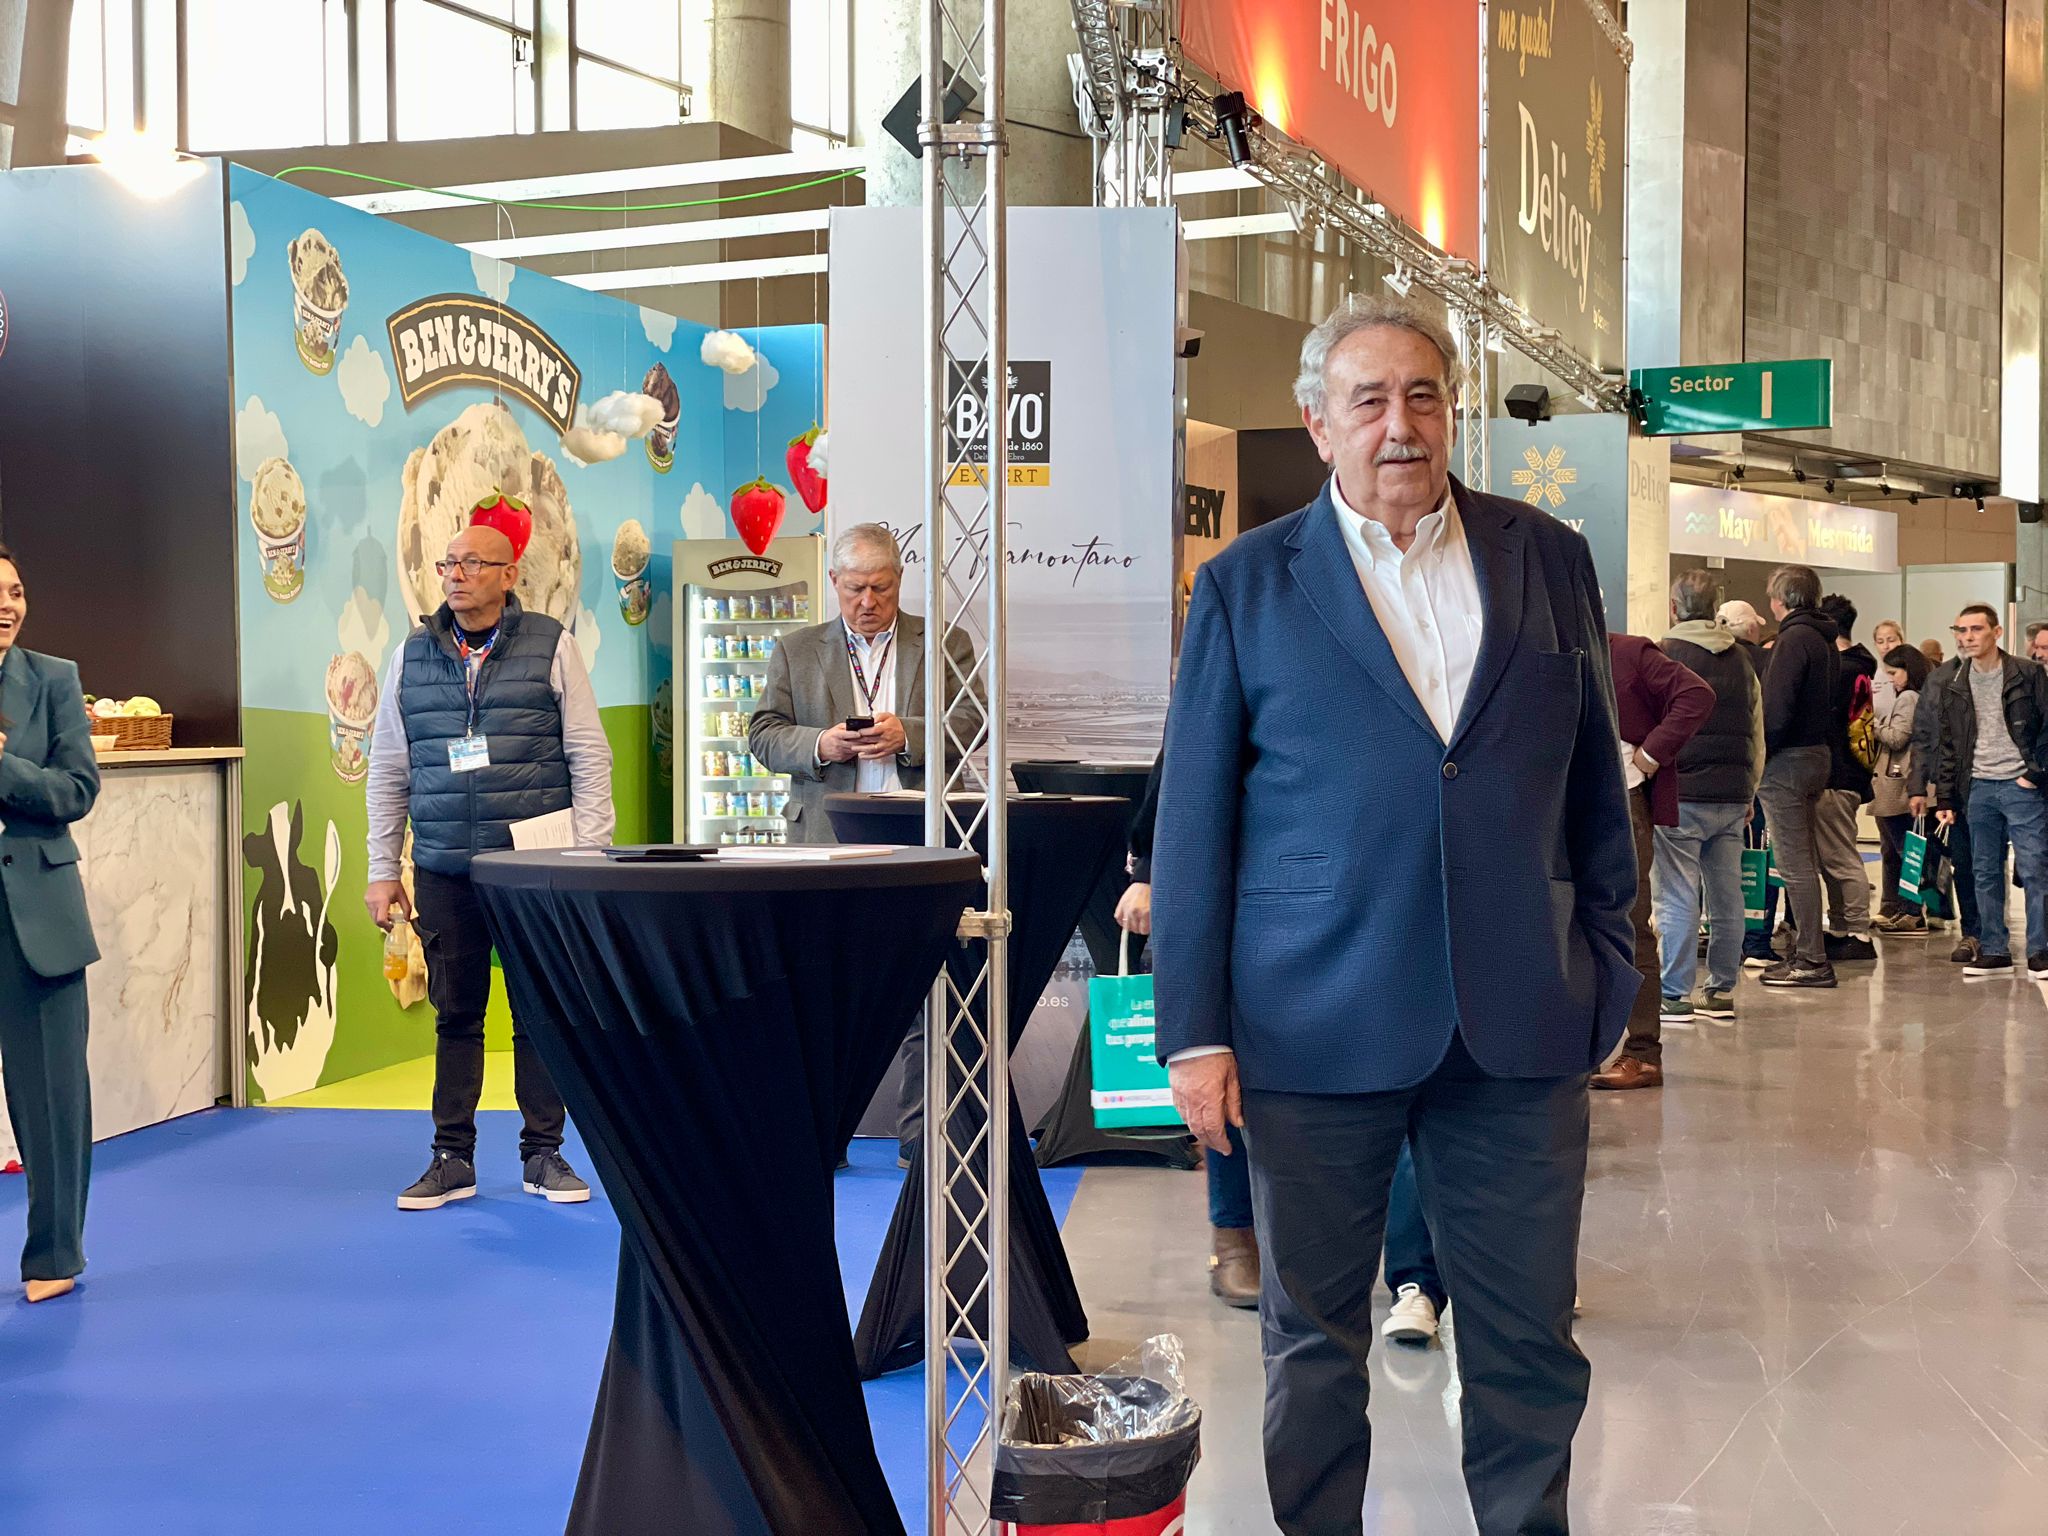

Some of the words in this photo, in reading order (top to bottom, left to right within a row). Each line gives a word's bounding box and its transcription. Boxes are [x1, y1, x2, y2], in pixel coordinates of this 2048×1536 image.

[1498, 9, 1517, 52] me
[1520, 0, 1555, 77] gusta!
[1320, 0, 1397, 128] FRIGO
[1518, 101, 1591, 313] Delicy
[1669, 375, 1735, 393] Sector
[1022, 442, 1043, 450] 1860
[960, 468, 1038, 483] EXRT
[1184, 484, 1225, 539] ERY
[1807, 518, 1874, 555] Mesquida
